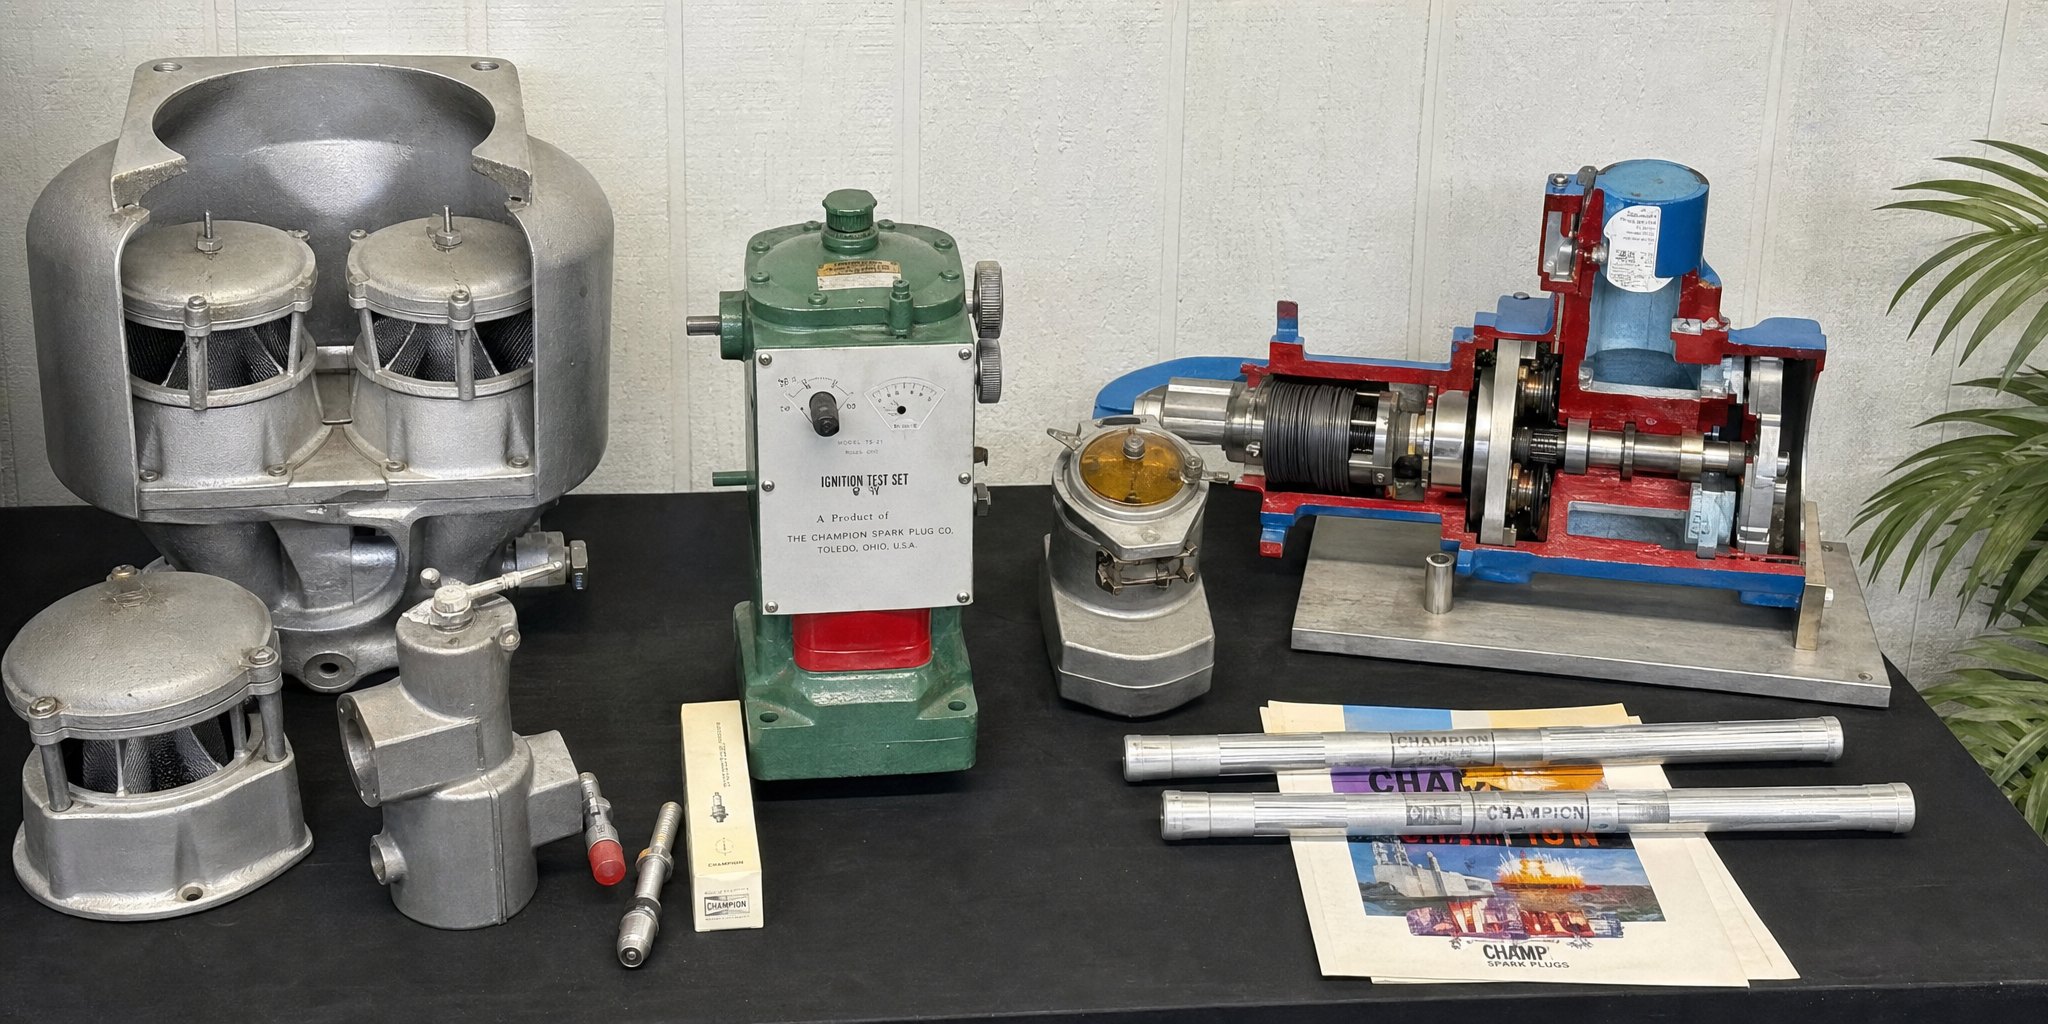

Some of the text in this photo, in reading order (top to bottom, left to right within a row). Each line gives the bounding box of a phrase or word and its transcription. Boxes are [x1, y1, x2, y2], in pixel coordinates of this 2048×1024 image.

[821, 473, 909, 488] IGNITION TEST SET
[816, 511, 889, 524] A Product of
[787, 534, 807, 543] THE
[811, 531, 867, 542] CHAMPION
[872, 528, 904, 538] SPARK
[909, 527, 934, 536] PLUG
[1397, 735, 1489, 748] CHAMPION
[1487, 806, 1585, 821] CHAMPION
[706, 900, 747, 912] CHAMPION
[1487, 960, 1570, 969] SPARK PLUGS
